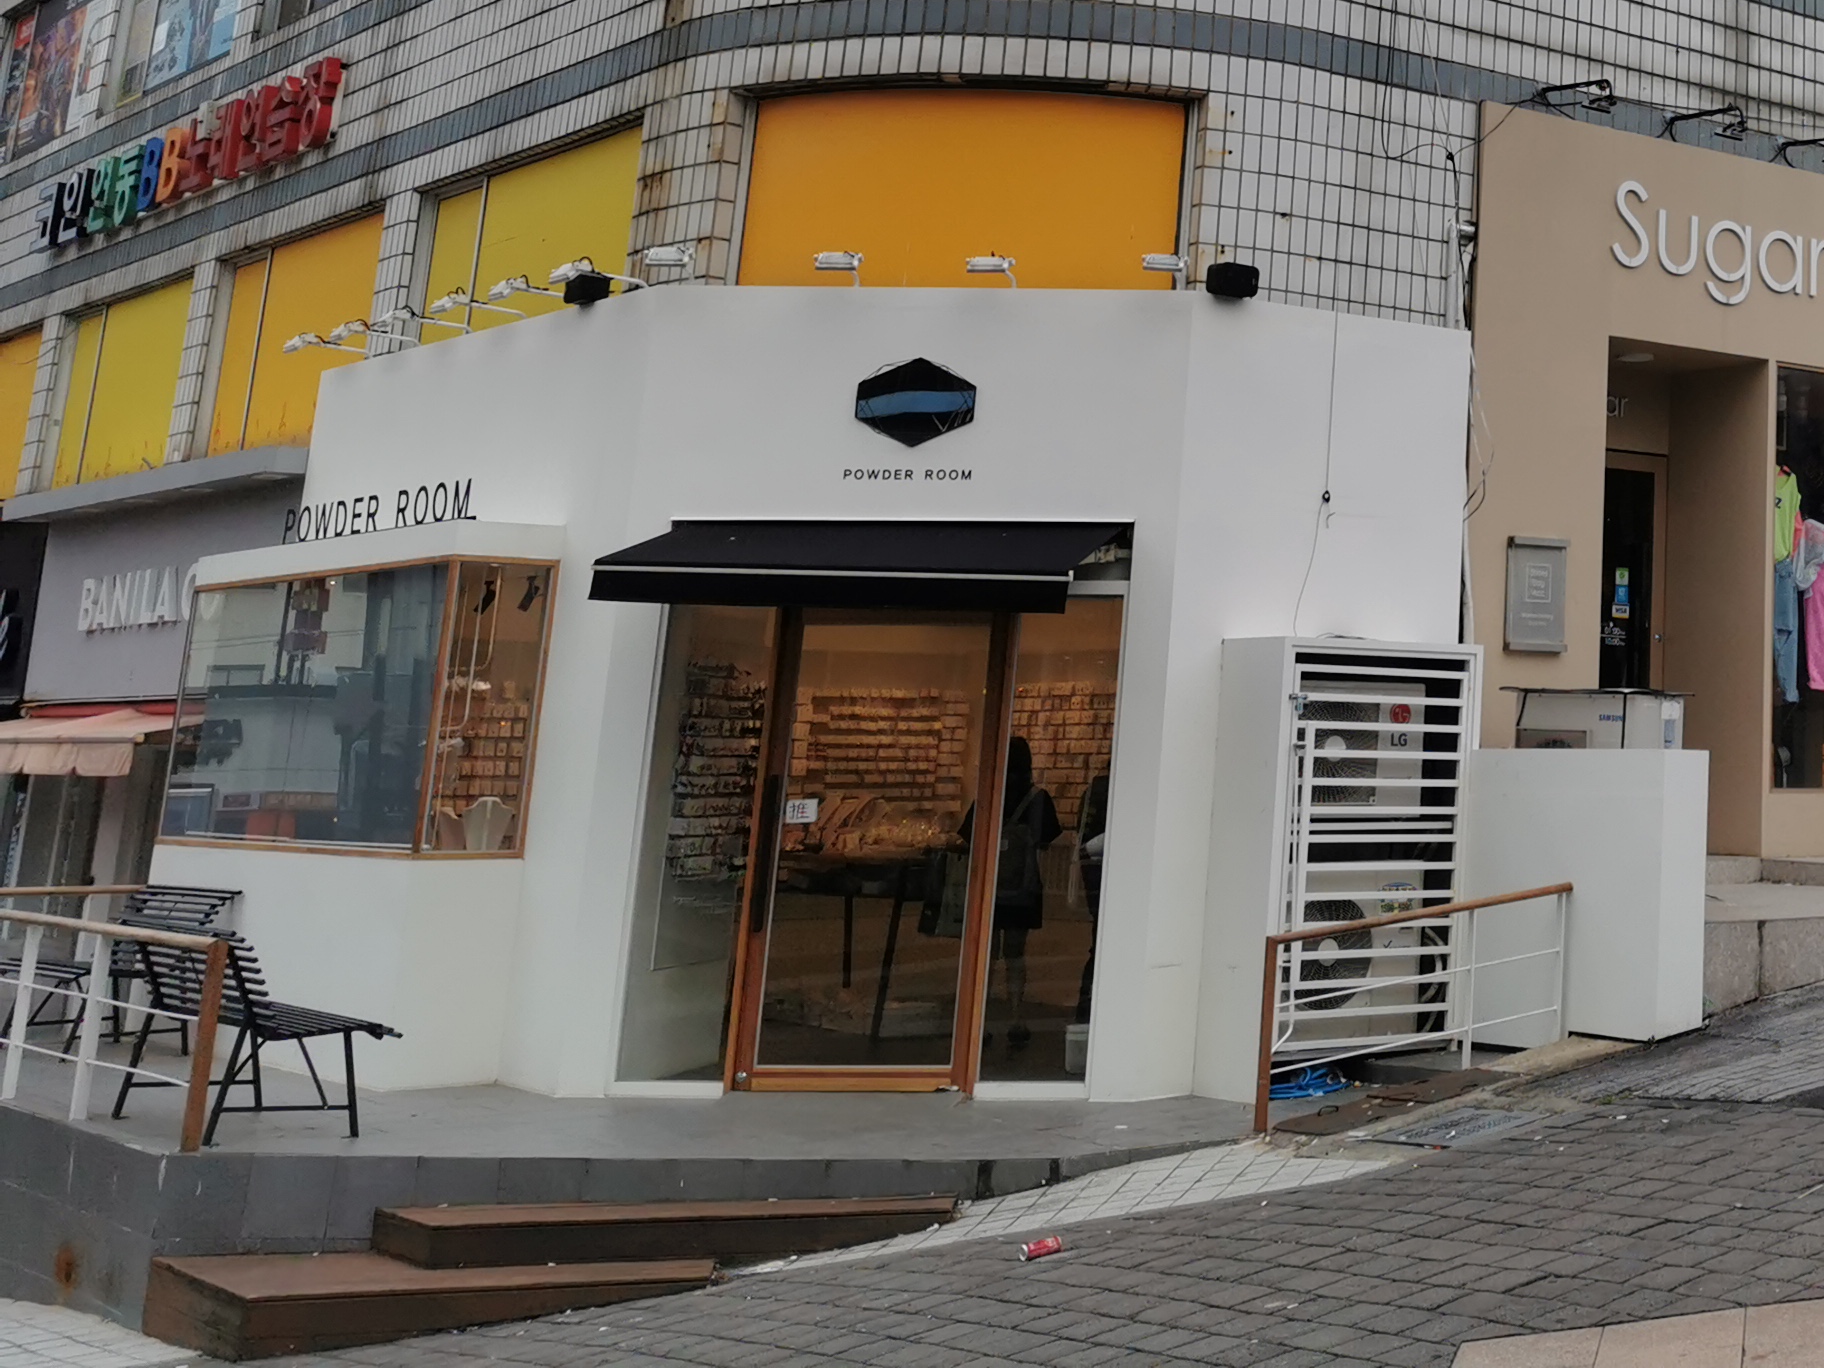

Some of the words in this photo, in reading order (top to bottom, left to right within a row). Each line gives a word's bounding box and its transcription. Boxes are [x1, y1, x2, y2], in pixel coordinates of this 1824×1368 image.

[841, 468, 915, 481] POWDER
[924, 469, 973, 481] ROOM
[281, 494, 380, 545] POWDER
[395, 478, 476, 529] ROOM
[77, 566, 178, 632] BANILA
[1598, 713, 1624, 723] SAMSUN
[1390, 733, 1408, 747] LG
